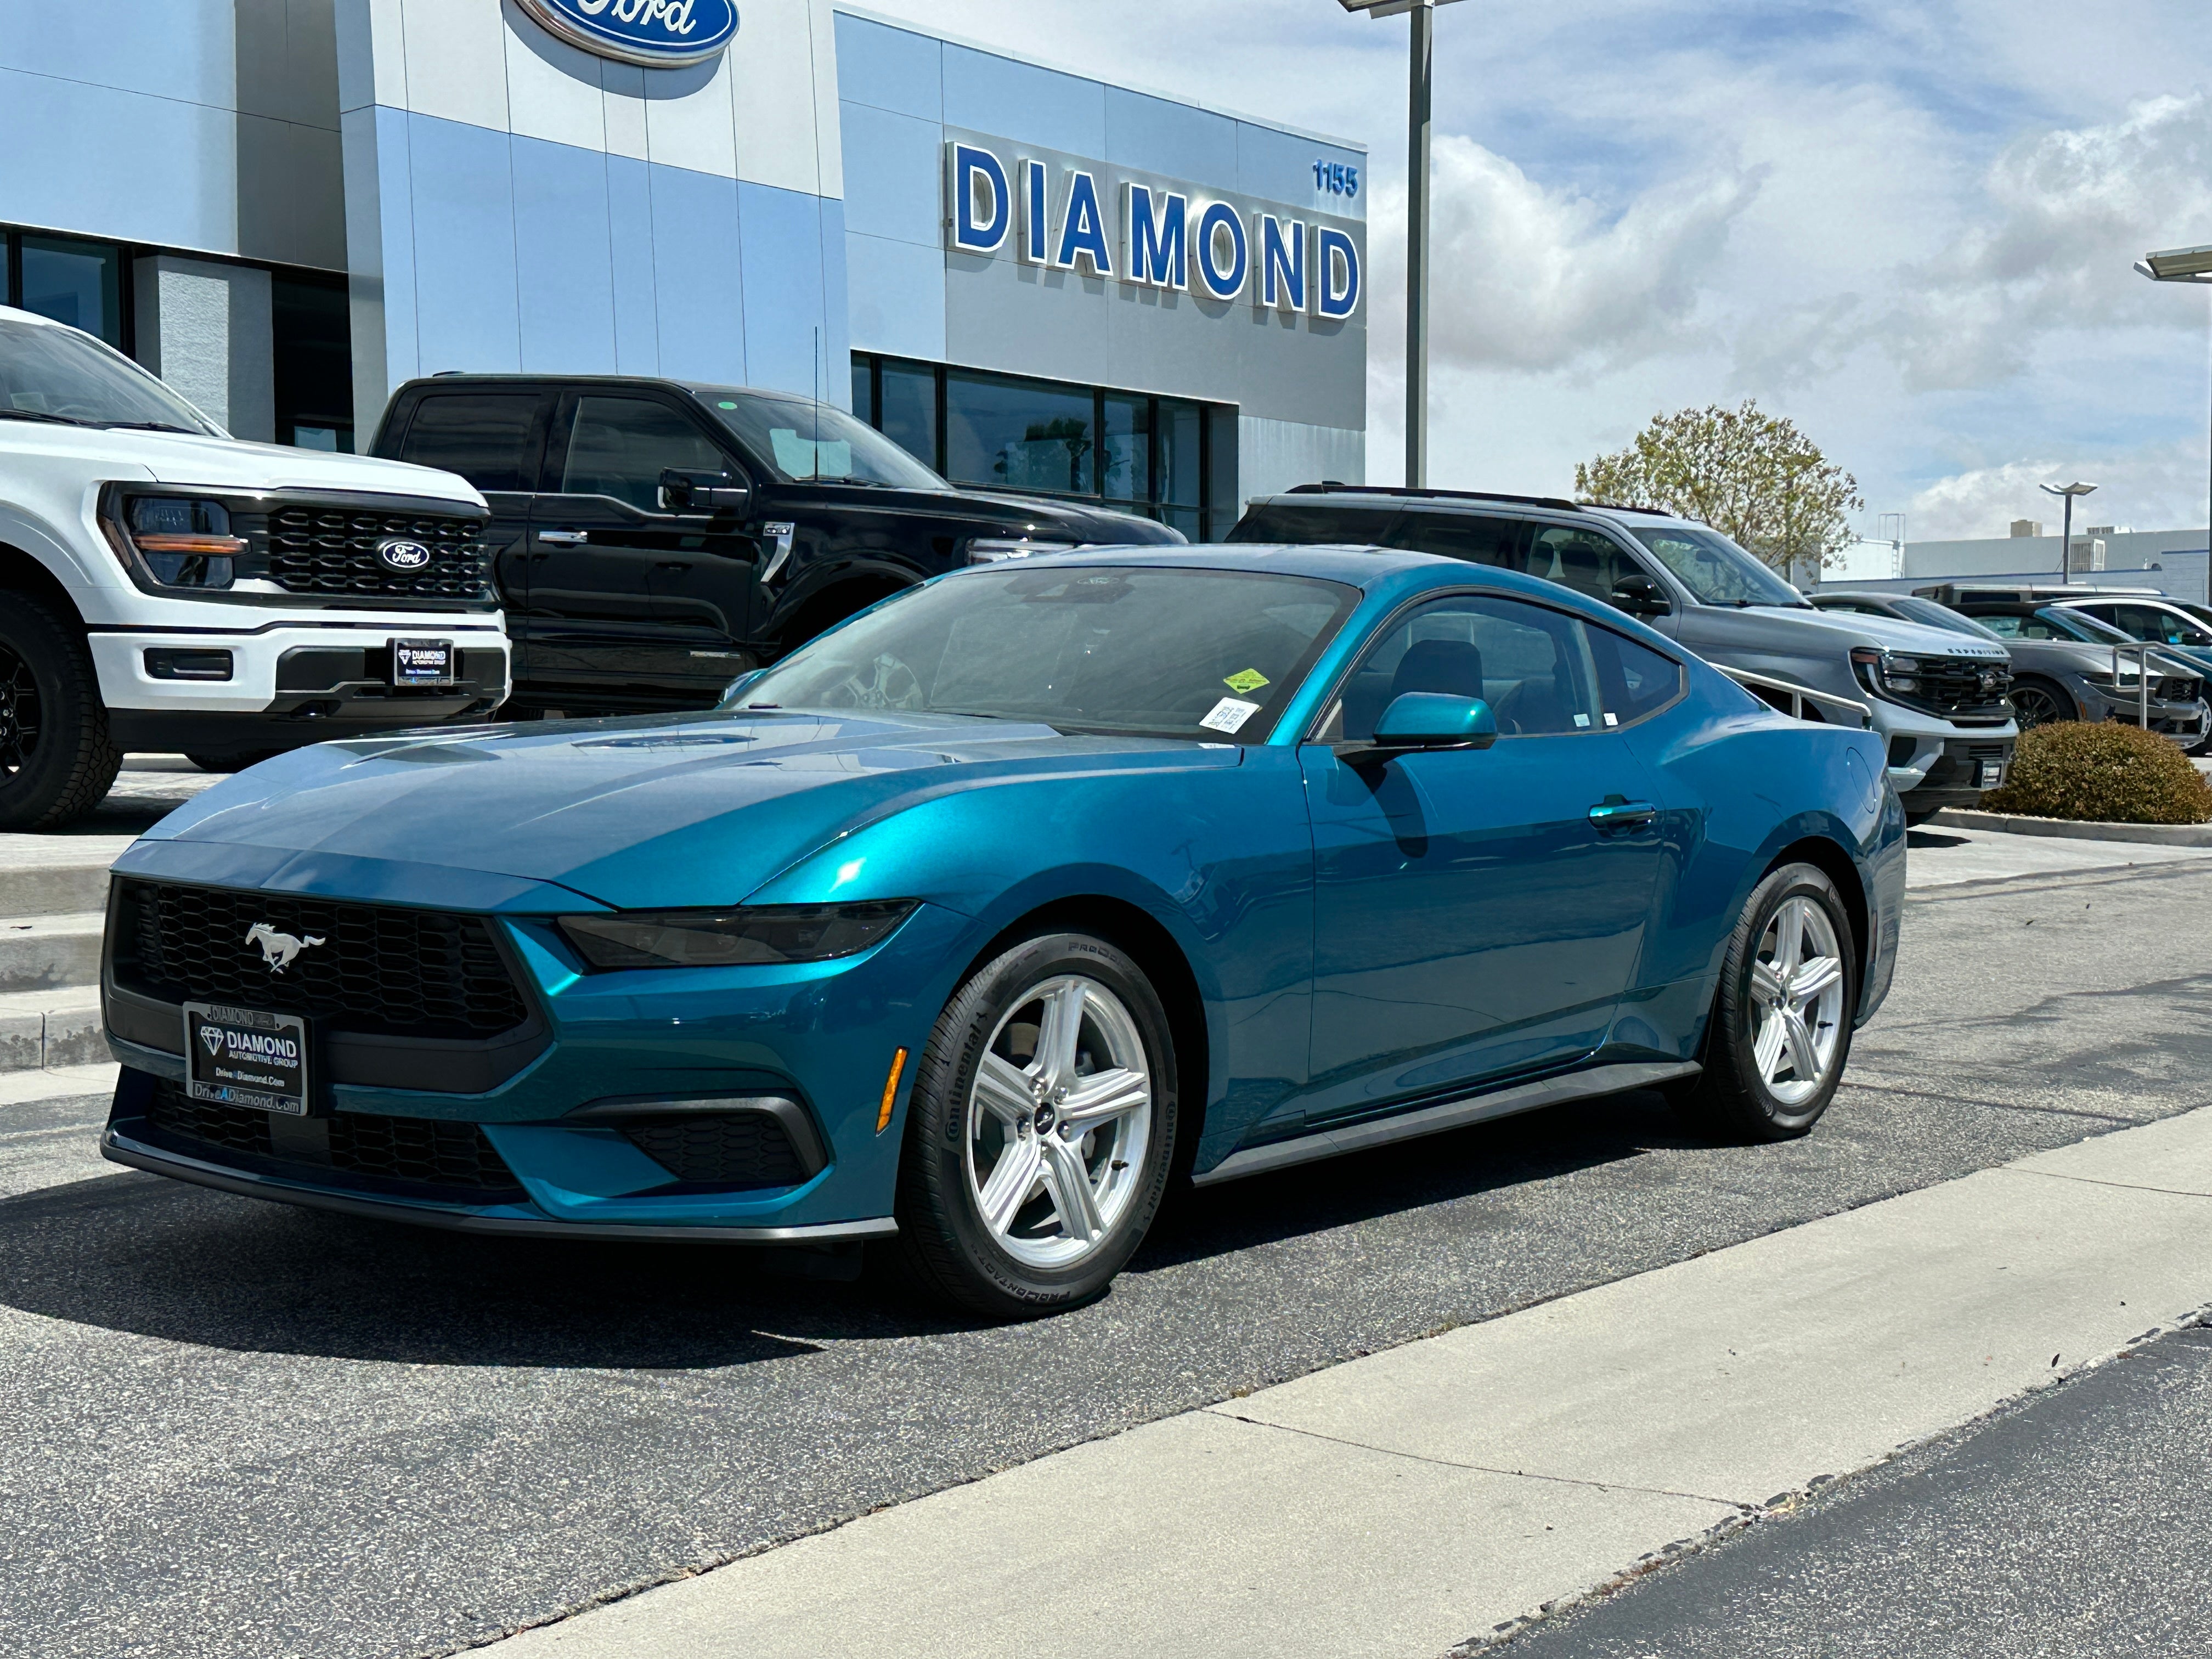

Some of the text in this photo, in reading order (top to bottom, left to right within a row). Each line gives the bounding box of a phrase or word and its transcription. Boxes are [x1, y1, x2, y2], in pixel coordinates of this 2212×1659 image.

[578, 0, 697, 35] ord
[1312, 159, 1358, 198] 1155
[952, 140, 1361, 320] DIAMOND
[392, 544, 421, 565] Ford
[210, 1006, 254, 1026] DIAMOND
[226, 1030, 297, 1058] DIAMOND
[228, 1049, 298, 1069] AUTOMOTIVE GROUP
[945, 1023, 983, 1143] Continental
